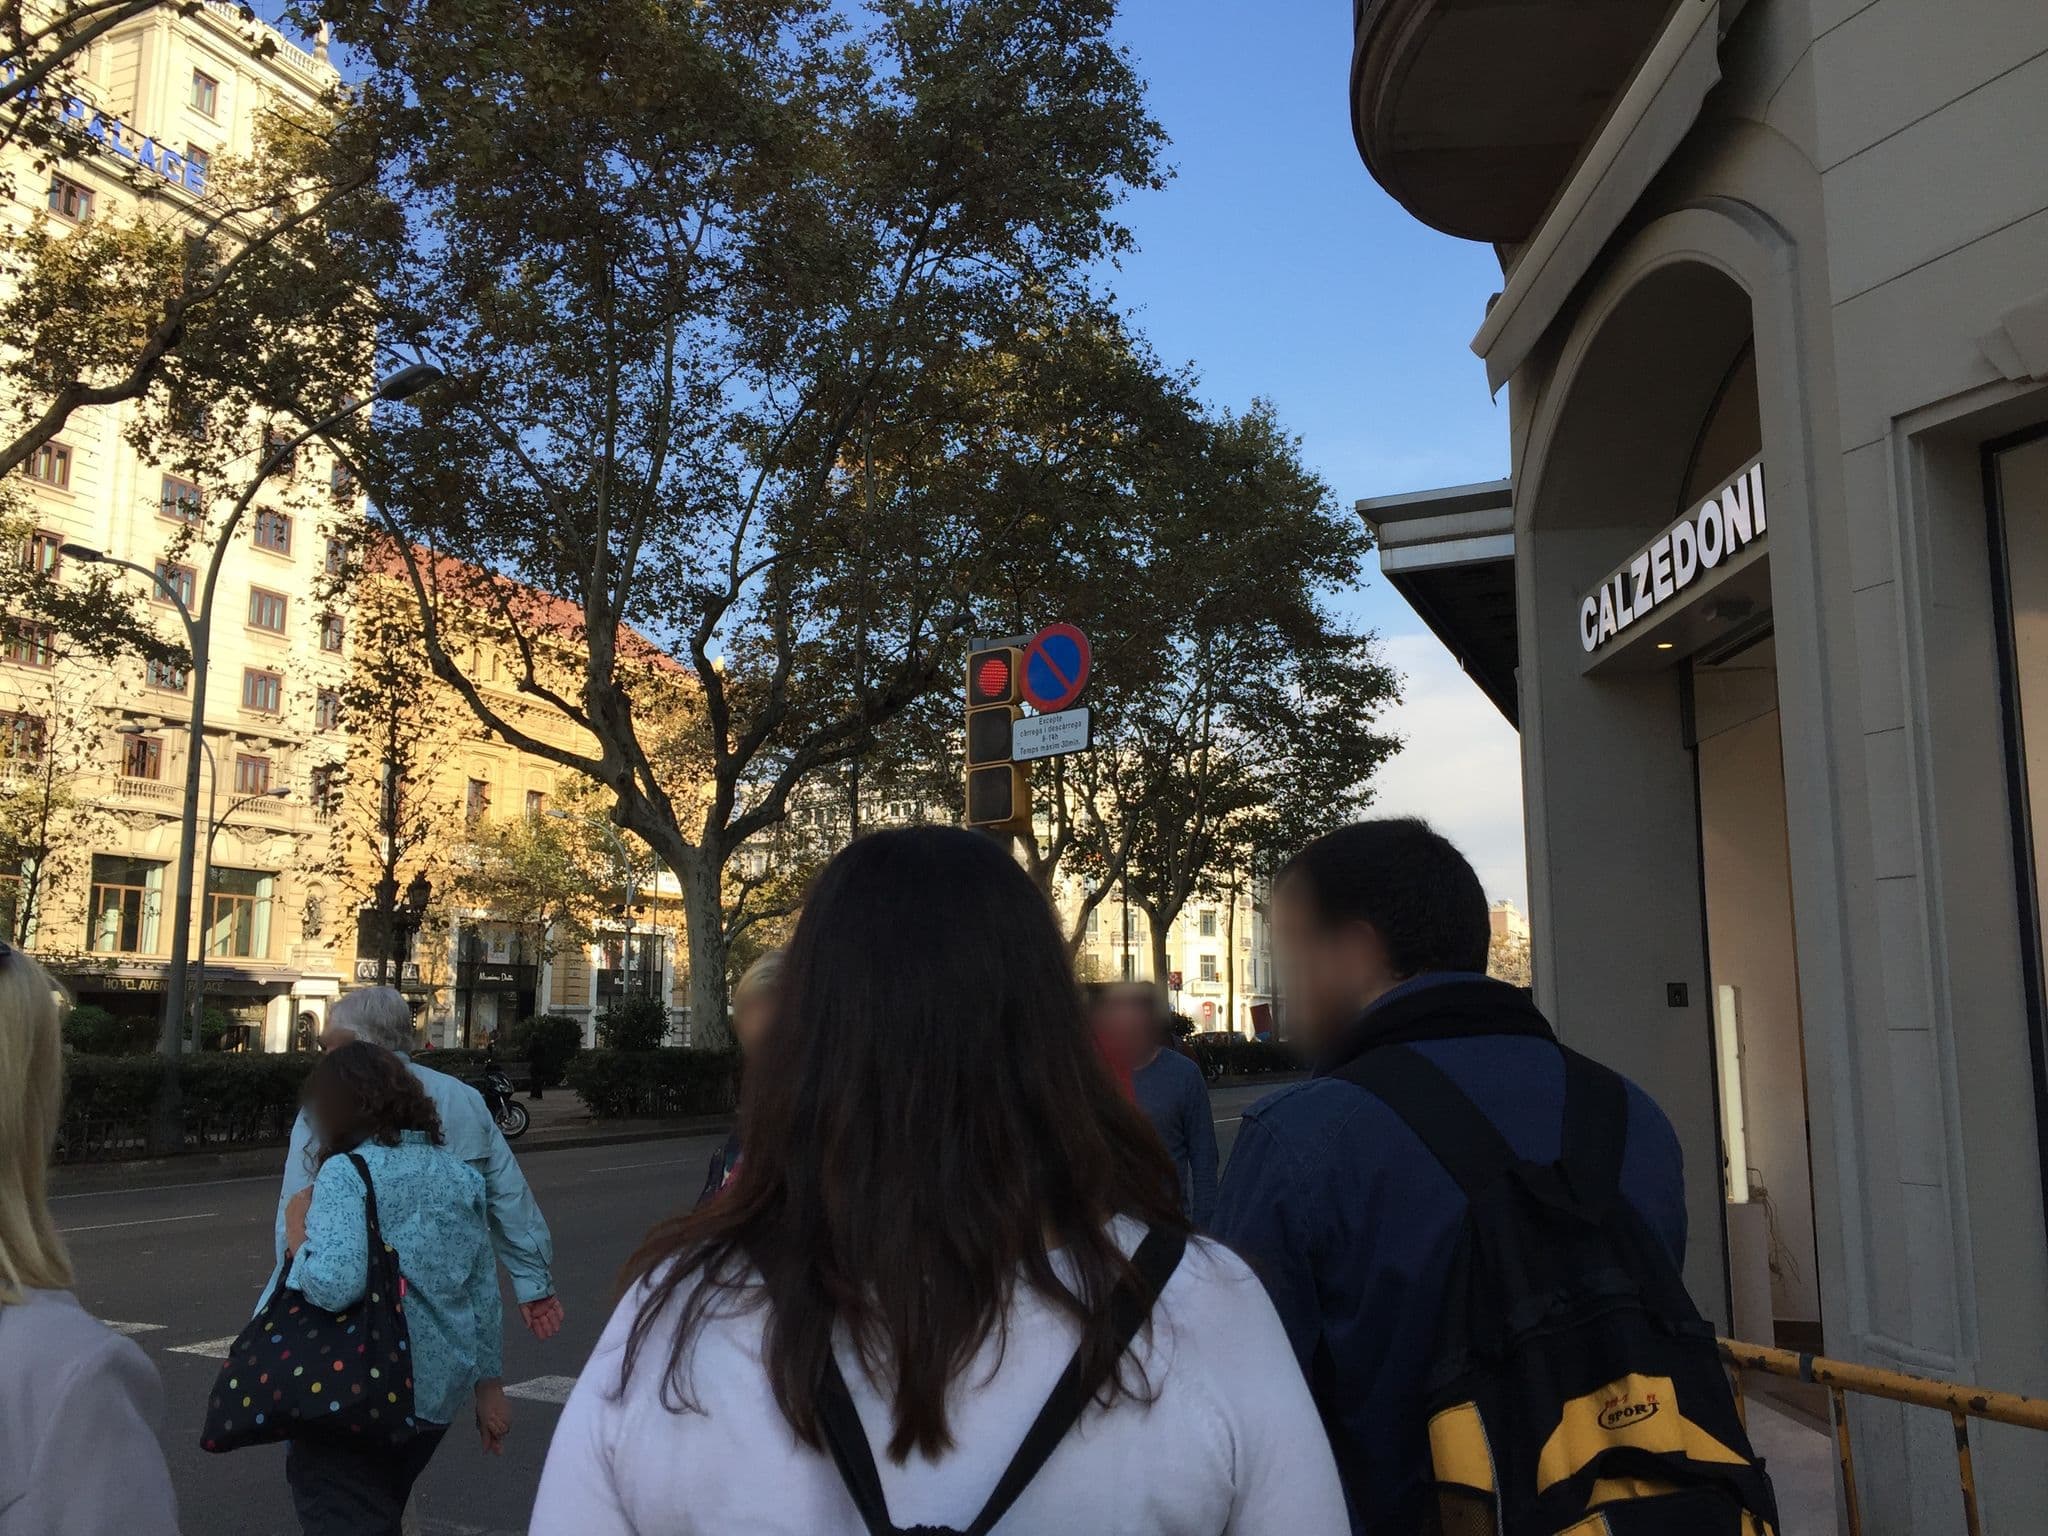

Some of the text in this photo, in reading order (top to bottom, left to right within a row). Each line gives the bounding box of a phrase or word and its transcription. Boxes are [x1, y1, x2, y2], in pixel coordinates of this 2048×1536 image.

[60, 95, 206, 196] PALACE
[1039, 715, 1063, 725] Excepte
[1020, 746, 1039, 756] Temps
[103, 978, 137, 990] HOTEL
[188, 981, 224, 992] PAACE
[1608, 1402, 1660, 1425] SPORT
